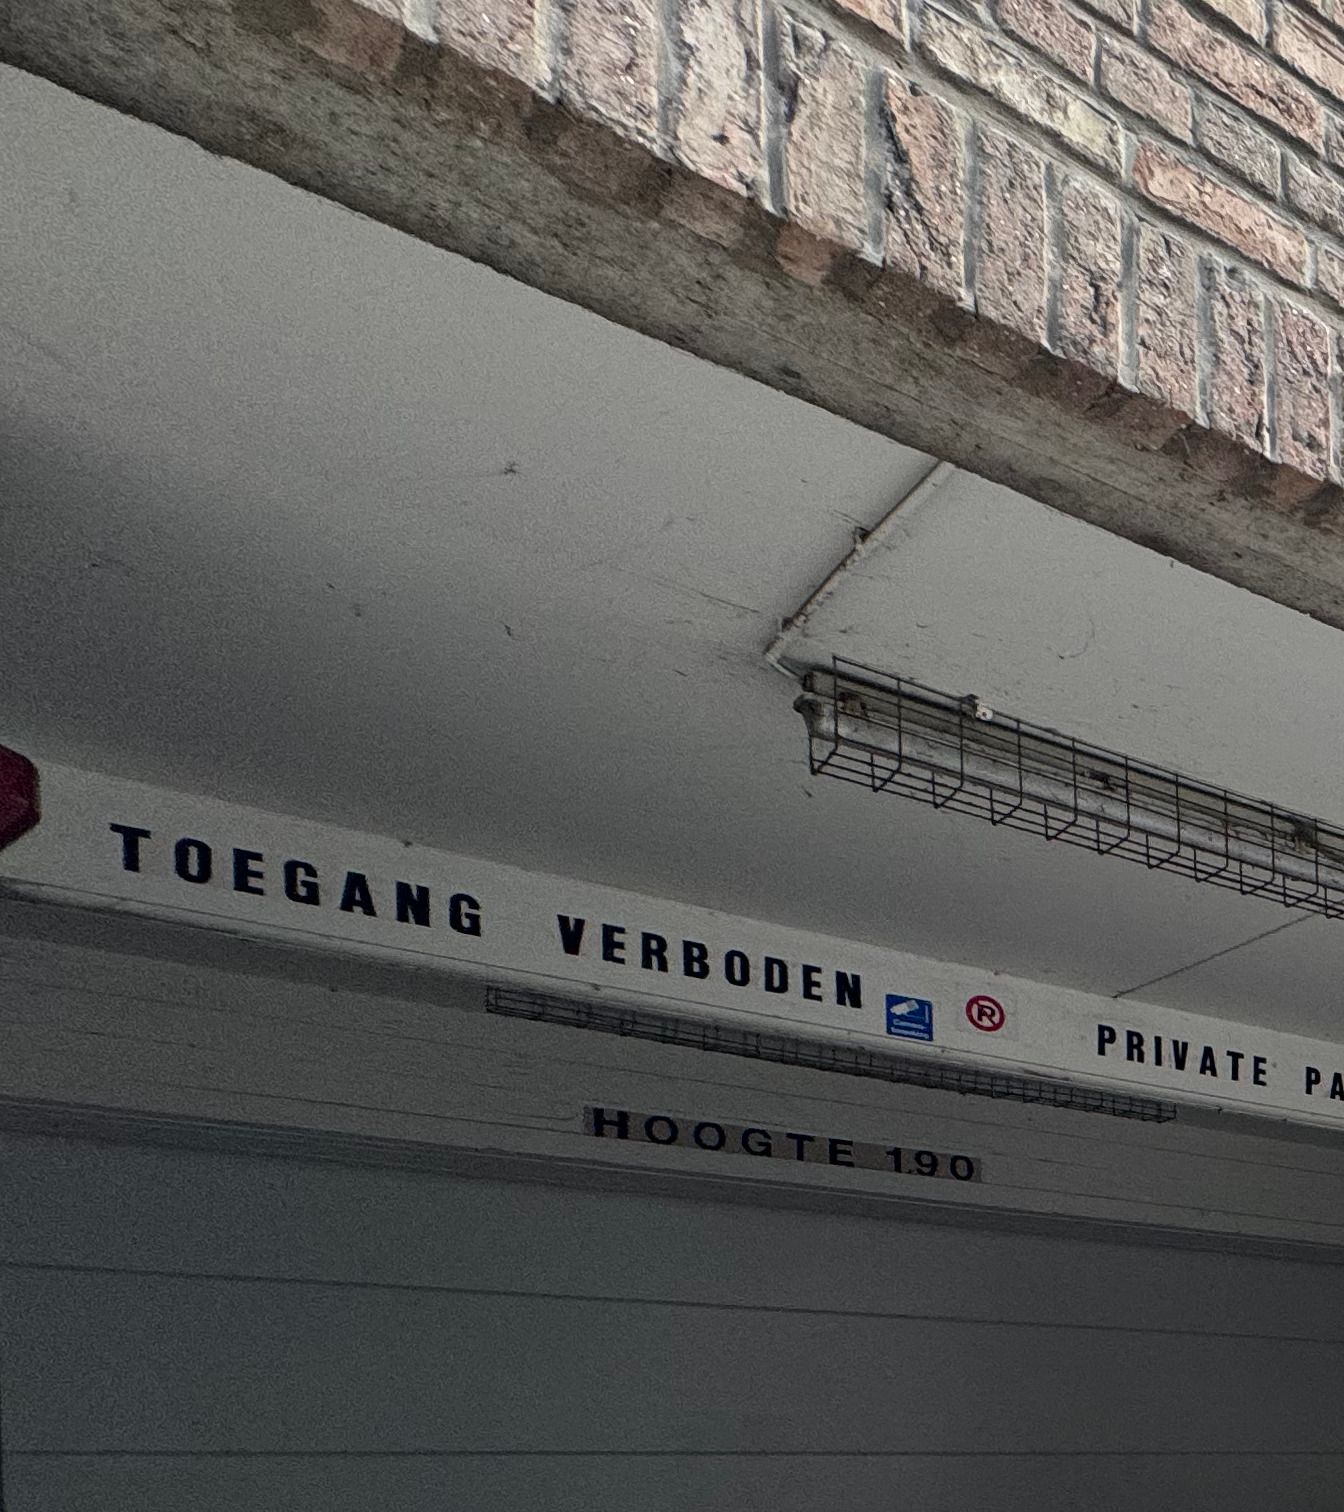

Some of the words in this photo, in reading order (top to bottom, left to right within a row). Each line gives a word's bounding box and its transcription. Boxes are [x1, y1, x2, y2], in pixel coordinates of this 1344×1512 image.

[109, 822, 483, 938] TOEGANG
[556, 913, 863, 1010] VERBODEN
[1096, 1023, 1268, 1088] PRIVATE
[591, 1107, 858, 1168] HOOGTE
